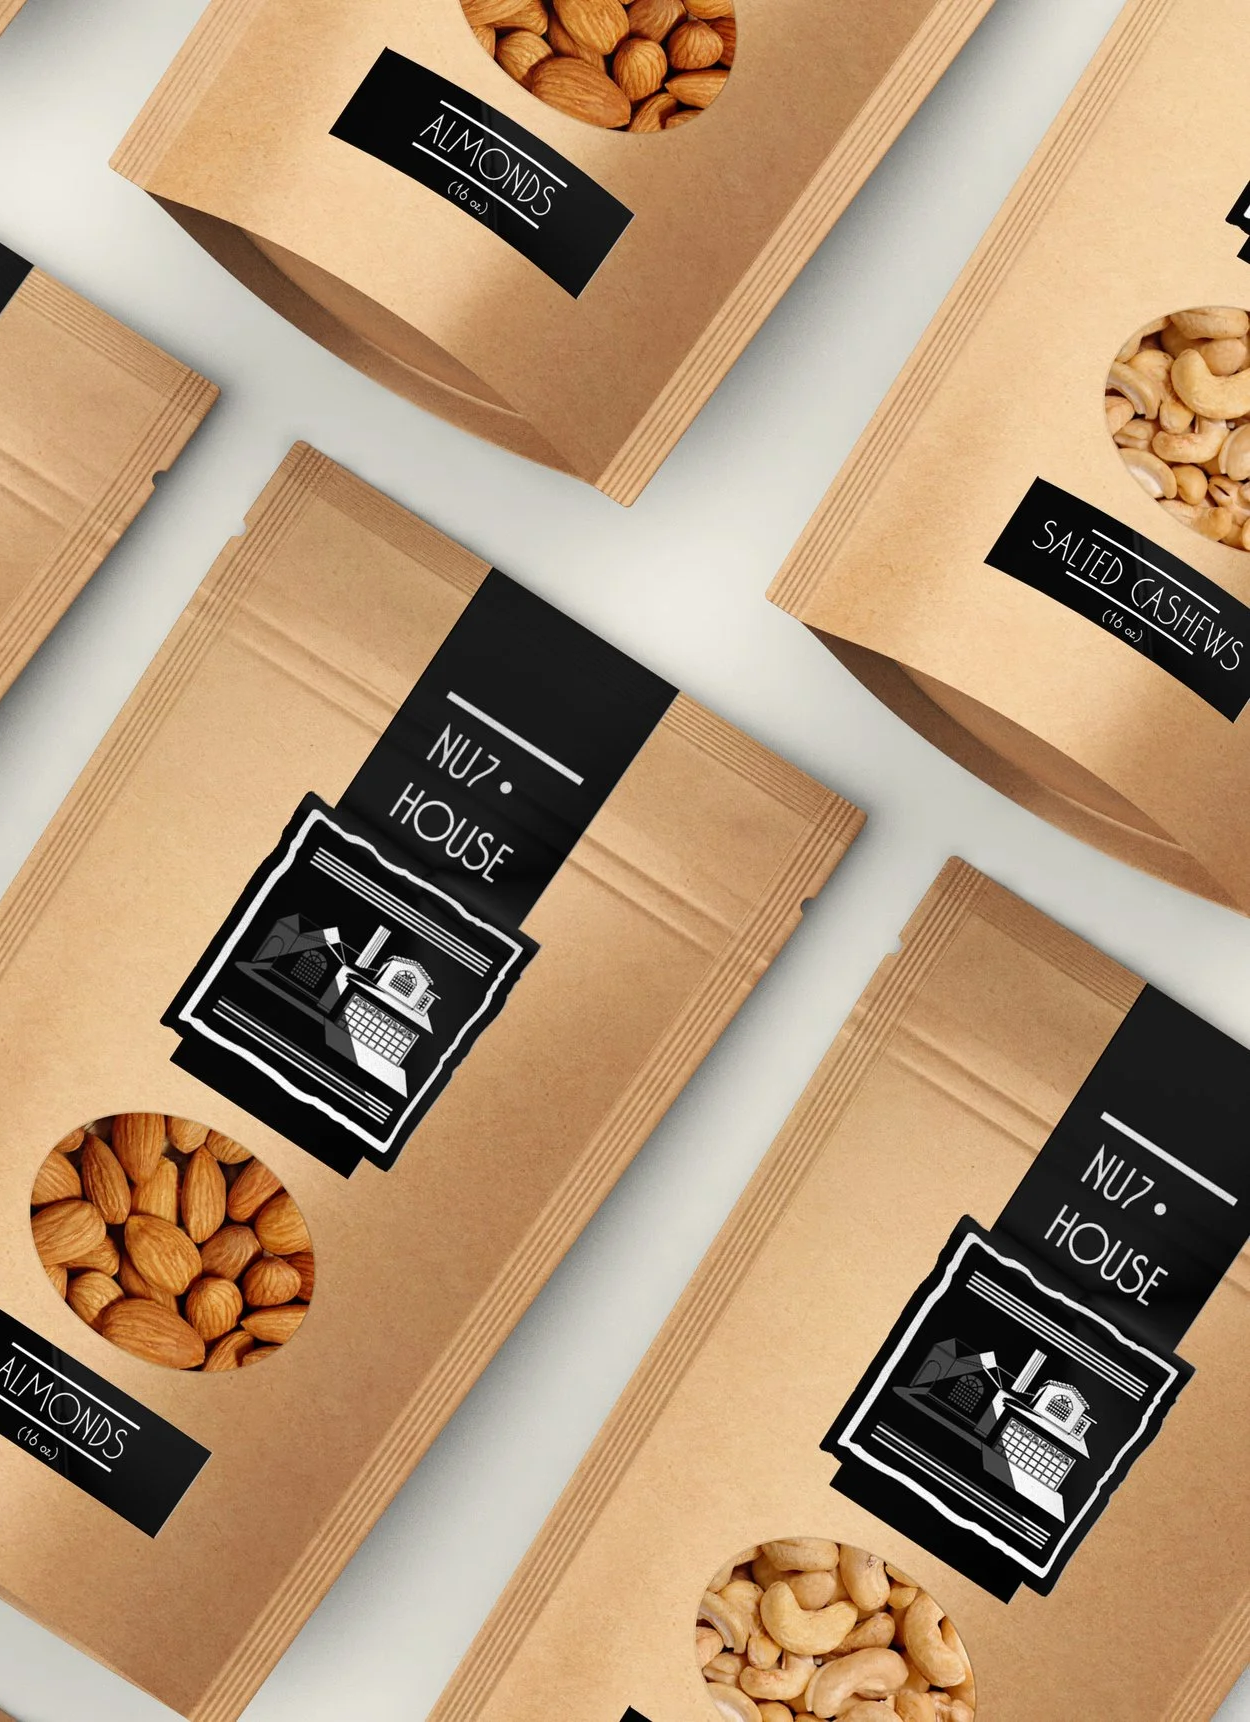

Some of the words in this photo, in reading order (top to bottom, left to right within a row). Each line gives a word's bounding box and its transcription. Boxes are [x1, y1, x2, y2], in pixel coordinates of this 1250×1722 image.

[419, 113, 556, 216] ALMONDS
[447, 180, 470, 201] (16
[1031, 519, 1124, 586] SALTED
[1130, 577, 1245, 672] CASHEWS
[1101, 609, 1125, 630] (16
[388, 781, 515, 884] HOUSE
[1043, 1203, 1170, 1307] HOUSE
[16, 1425, 41, 1447] (16
